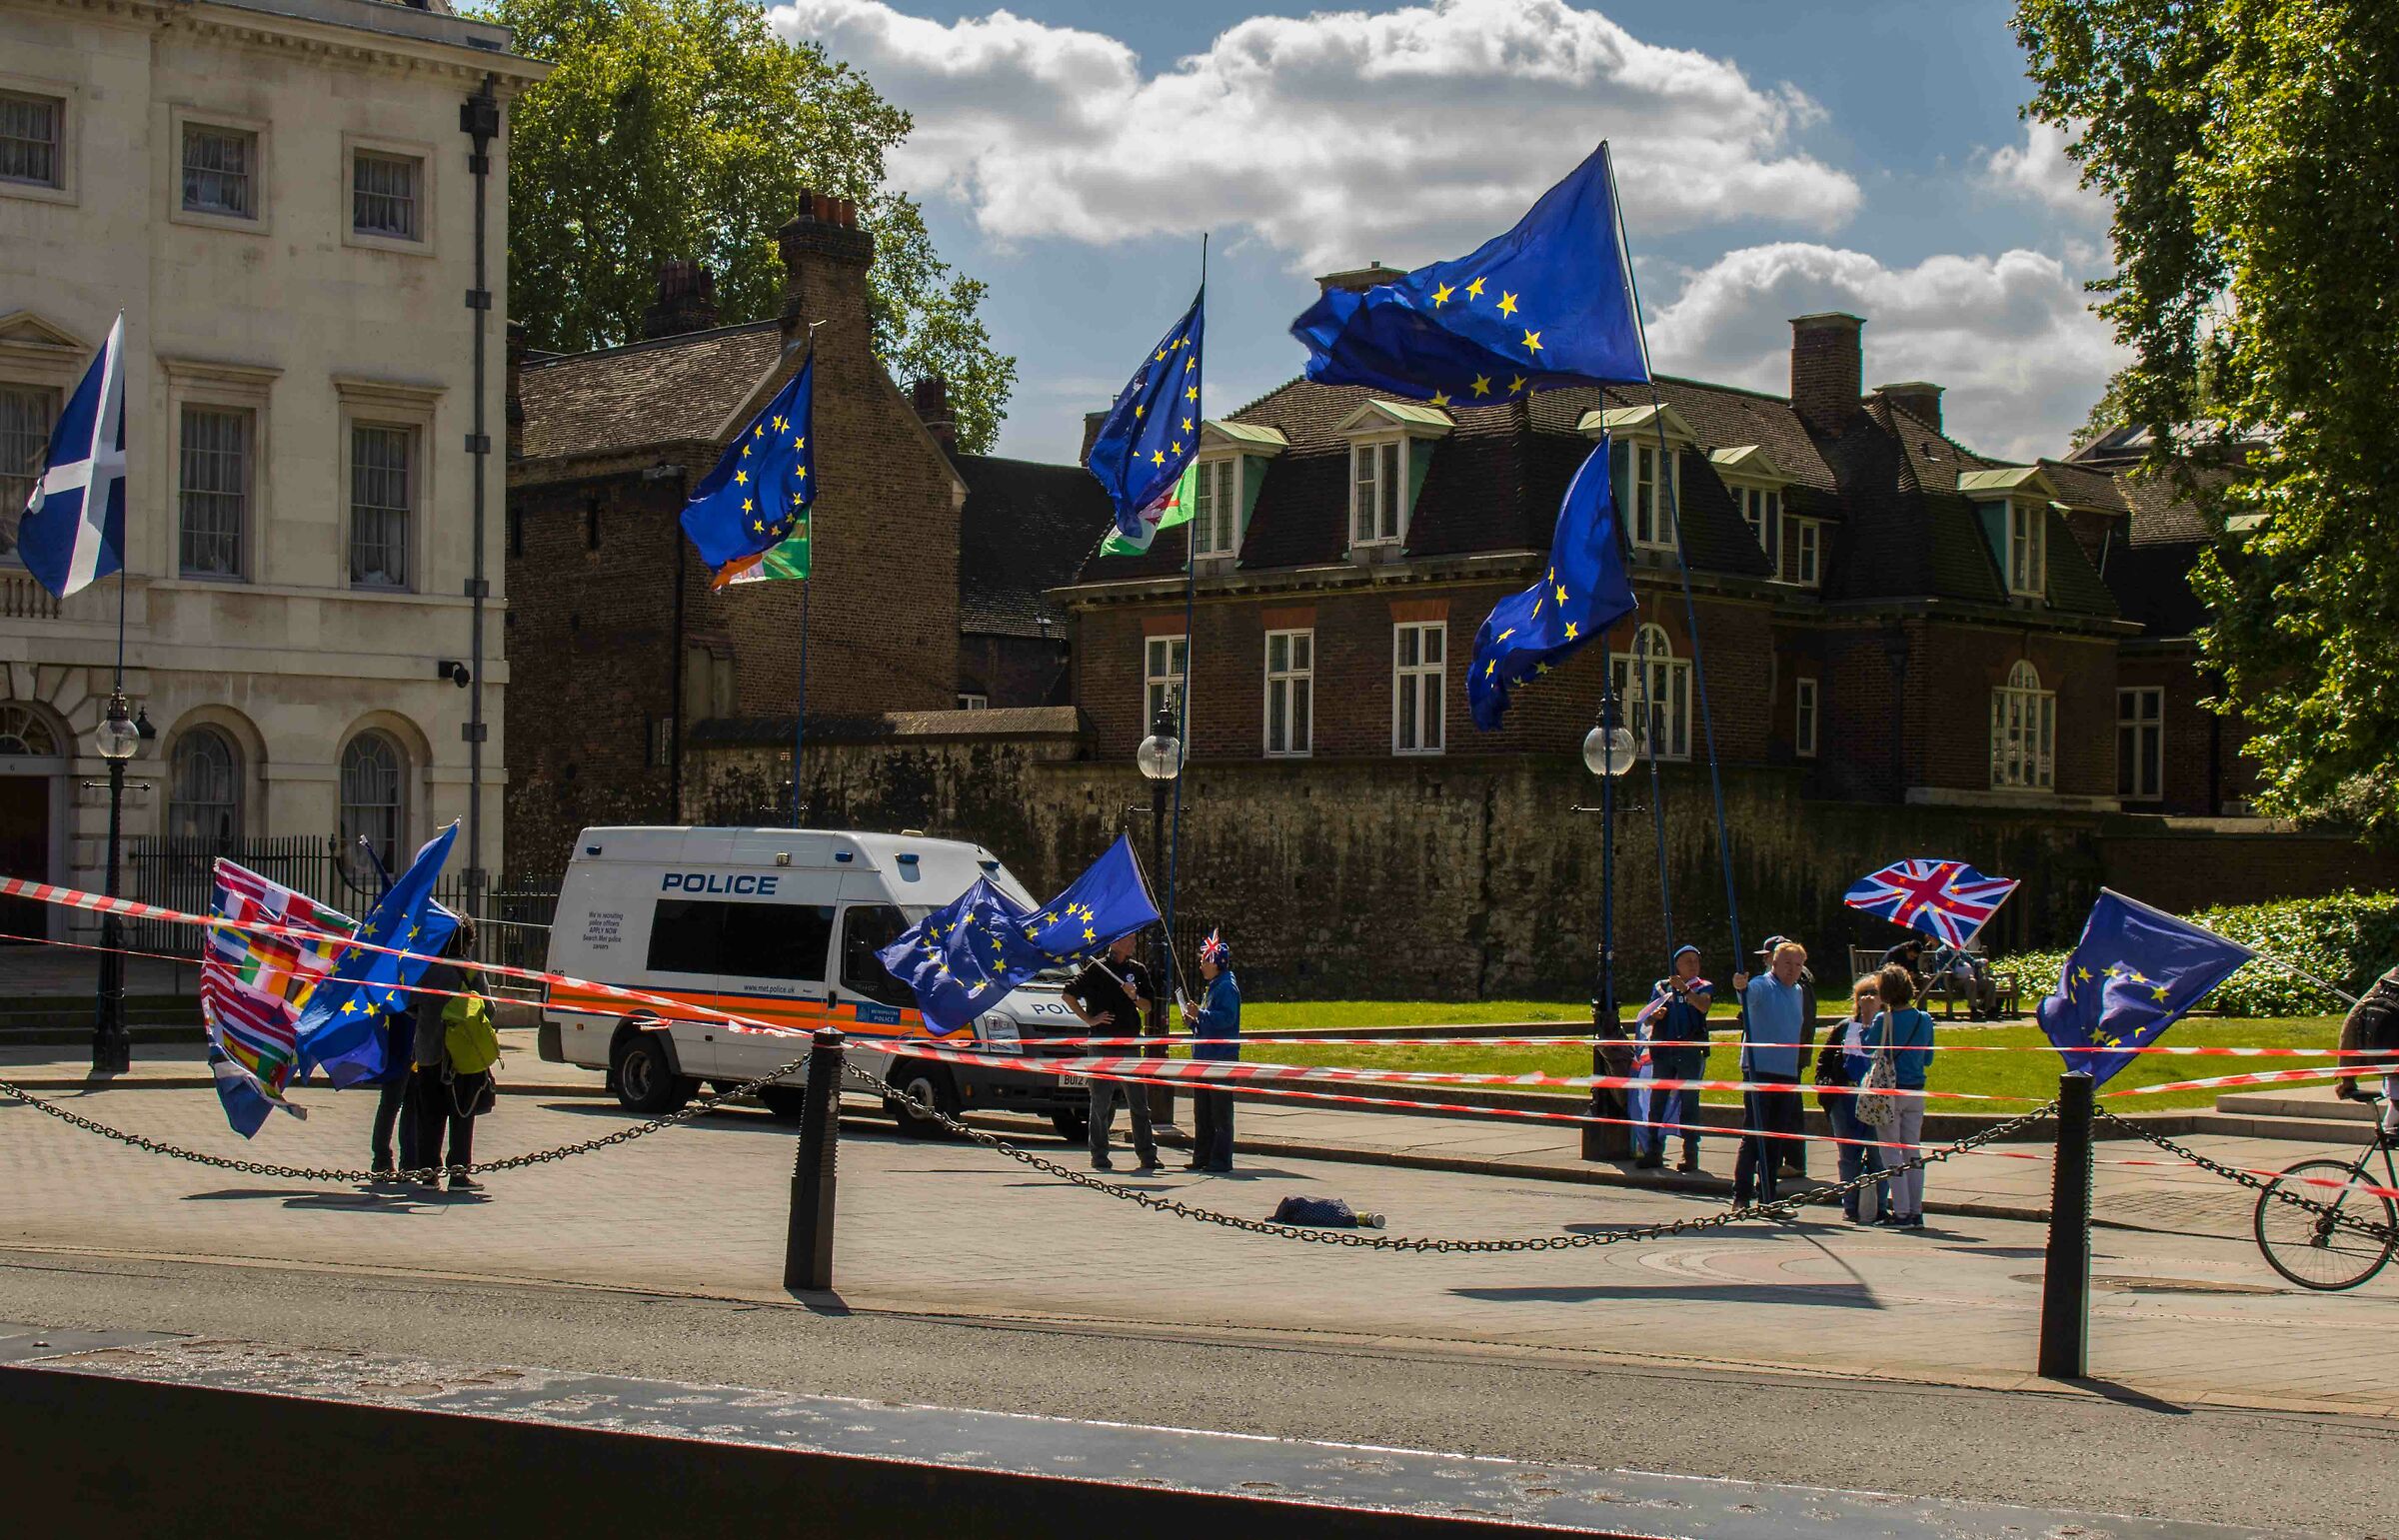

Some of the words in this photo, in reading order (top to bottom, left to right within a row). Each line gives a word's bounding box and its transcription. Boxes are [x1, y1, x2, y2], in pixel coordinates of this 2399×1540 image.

[662, 872, 779, 895] POLICE
[602, 911, 624, 920] recruiting
[603, 918, 620, 927] officers
[743, 983, 796, 994] www.met.police.uk
[1031, 1003, 1075, 1015] POL
